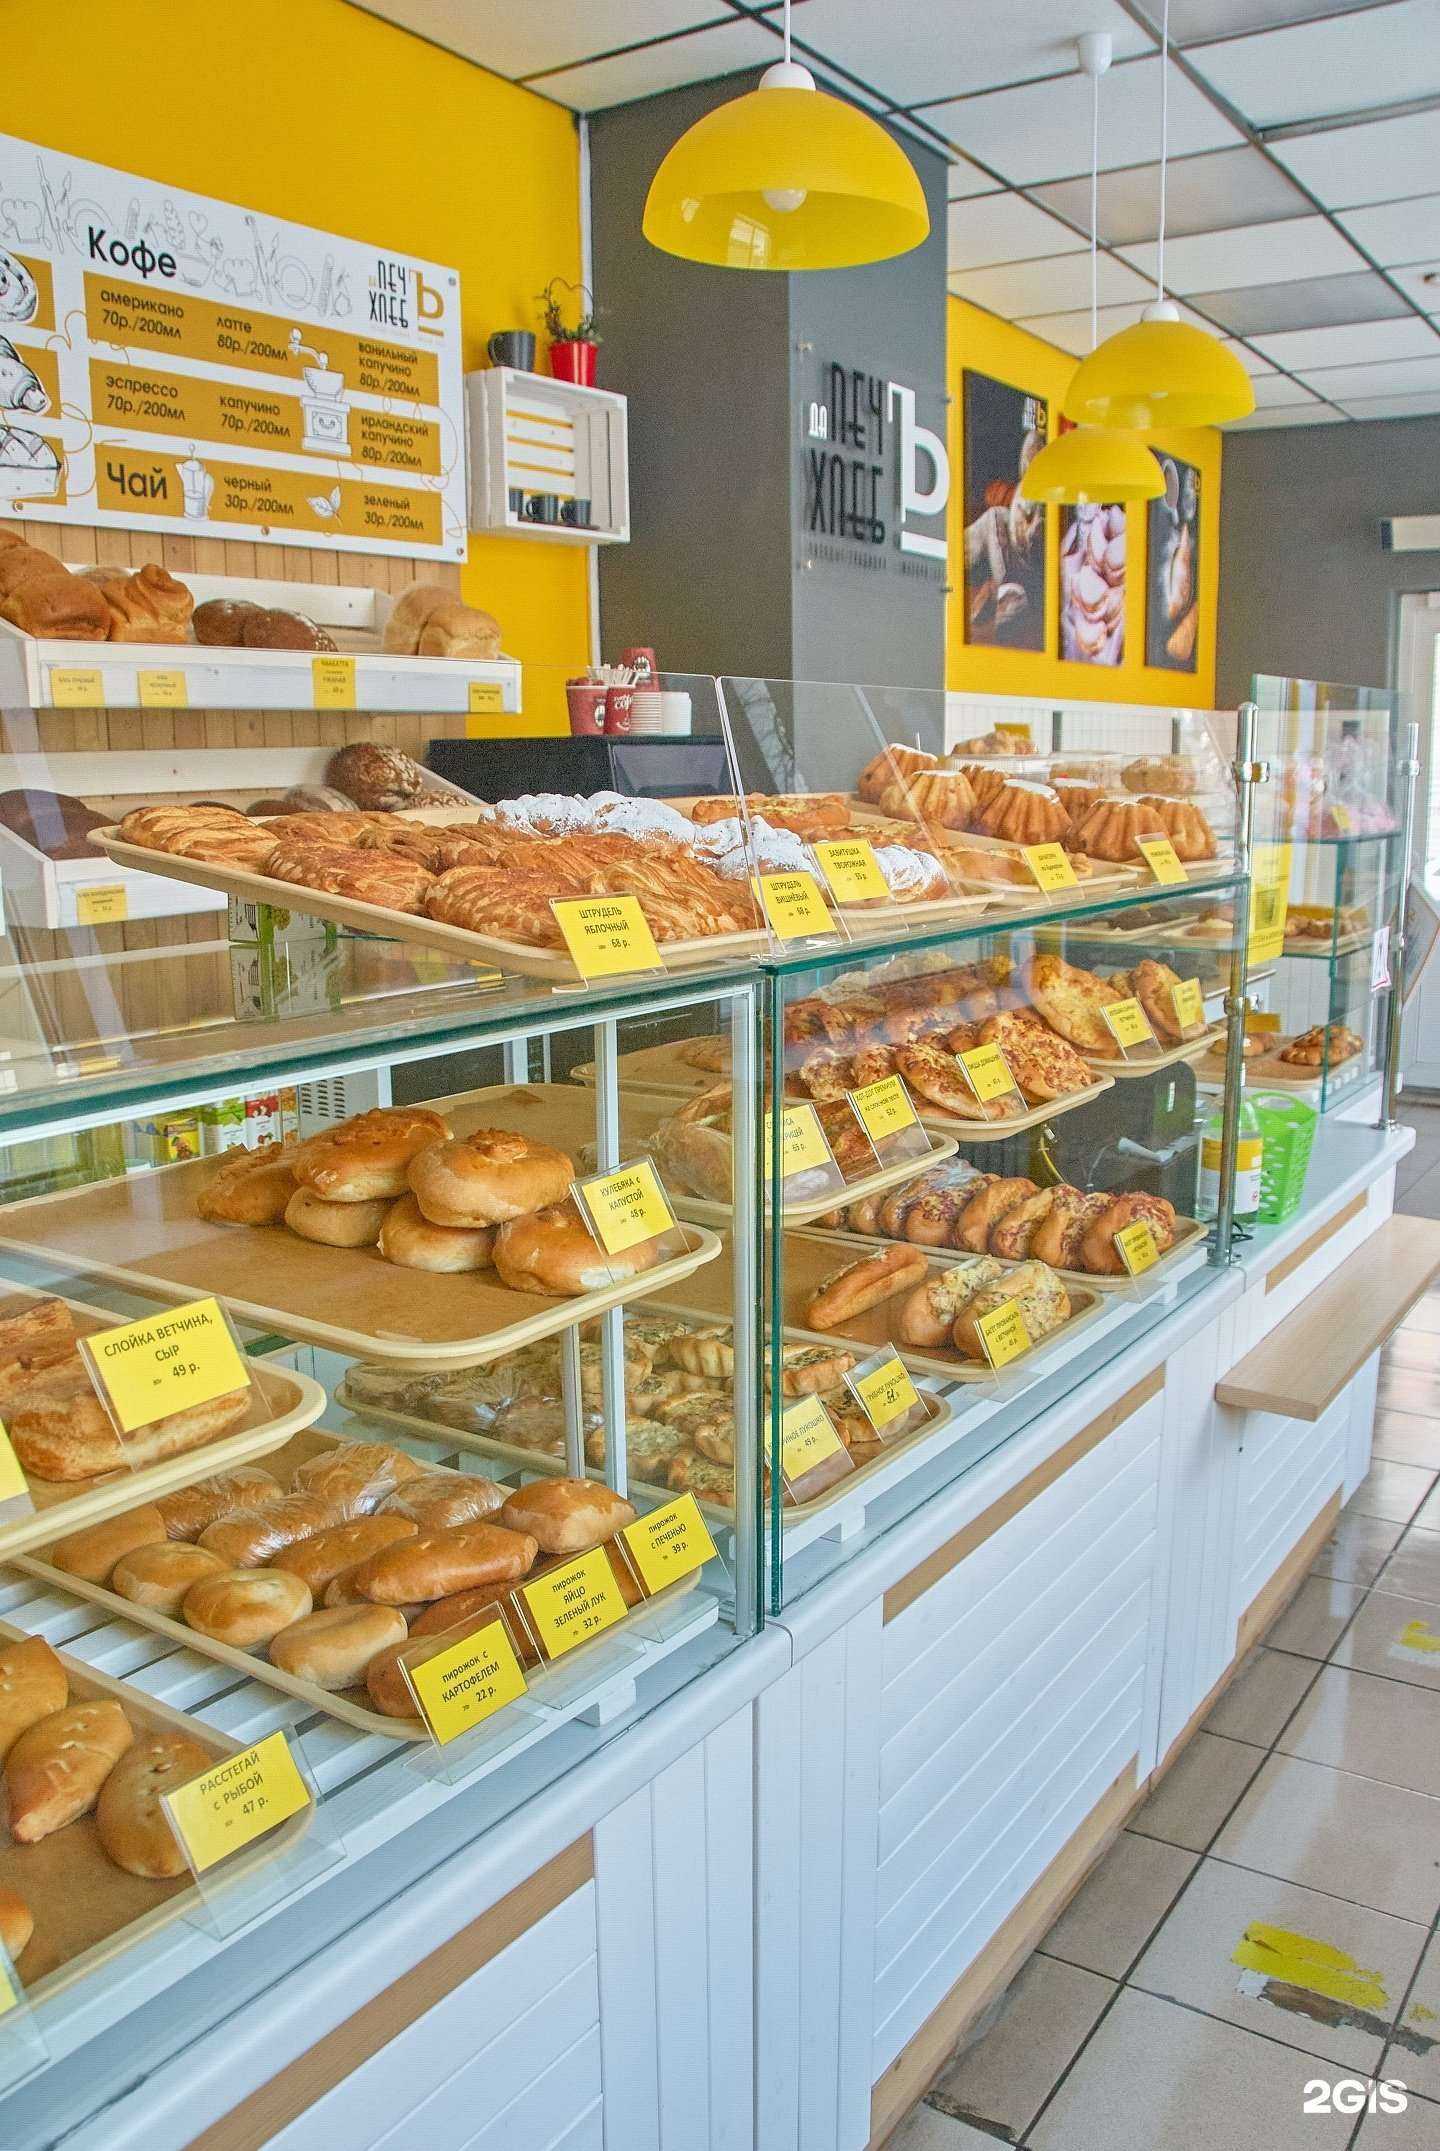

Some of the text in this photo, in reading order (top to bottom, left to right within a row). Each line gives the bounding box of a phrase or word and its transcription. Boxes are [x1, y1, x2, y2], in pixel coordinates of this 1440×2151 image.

[88, 226, 176, 279] Кофе
[101, 290, 184, 318] американо
[217, 316, 252, 333] латте
[359, 342, 418, 365] ванильный
[360, 356, 411, 377] капучино
[106, 375, 178, 399] эспрессо
[220, 396, 280, 416] капучино
[361, 416, 428, 437] ирландский
[361, 430, 413, 448] капучино
[106, 461, 167, 500] Чай
[223, 477, 272, 493] черный
[833, 859, 866, 870] ТВОРОЖНАЯ
[769, 880, 801, 891] ШТРУДЕЛЬ
[579, 907, 622, 919] ШТРУДЕЛЬ
[584, 919, 630, 935] ЯБЛОЧНЫЙ
[611, 938, 622, 948] 68
[622, 939, 631, 949] р.
[601, 1178, 635, 1198] КУЛЕБЯКА
[608, 1188, 644, 1211] КАПУСТОЙ
[639, 1208, 647, 1218] р.
[103, 1313, 213, 1357] СЛОЙКА ВЕТЧИНА,
[155, 1344, 180, 1361] СЫР
[172, 1363, 200, 1377] 49 р.
[799, 1414, 825, 1434] ЛУКОШКО
[649, 1513, 678, 1533] пирожок
[655, 1523, 687, 1547] ПЕЧЕНЬЮ
[671, 1541, 689, 1554] 39 р.
[552, 1570, 586, 1593] пирожок
[563, 1586, 586, 1604] ЯЙЦО
[553, 1592, 606, 1628] ЗЕЛЕНЫЙ ЛУК
[582, 1615, 602, 1629] 32 р.
[442, 1656, 480, 1683] пирожок
[442, 1661, 500, 1703] КАРТОФЕЛЕМ
[475, 1686, 497, 1703] 22 р.
[200, 1750, 261, 1795] РАССТЕГАЙ
[223, 1771, 264, 1804] РЫБОЙ
[242, 1797, 269, 1815] 47 р.
